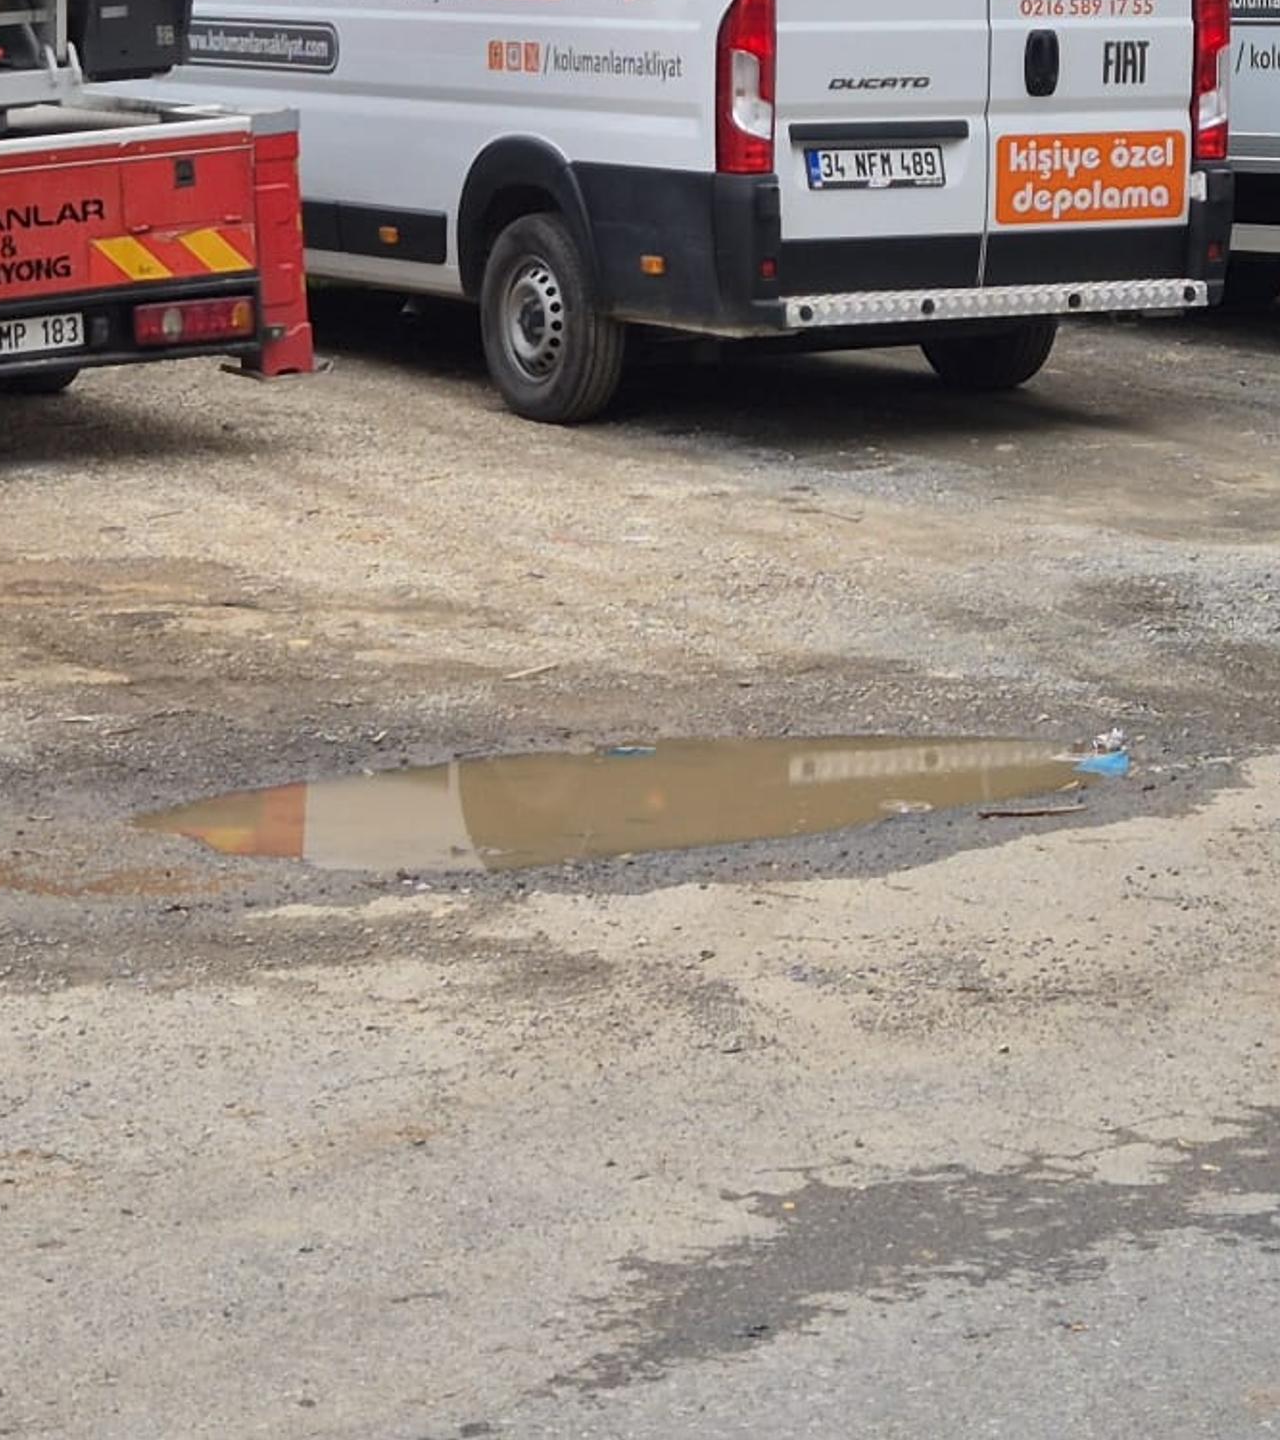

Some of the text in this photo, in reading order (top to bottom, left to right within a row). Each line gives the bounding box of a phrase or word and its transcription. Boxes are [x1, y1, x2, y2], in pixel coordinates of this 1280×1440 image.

[1103, 40, 1150, 84] FIAT
[828, 76, 930, 90] DUCATO
[821, 153, 845, 178] 34
[855, 152, 893, 178] NFM
[901, 151, 937, 176] 489
[1009, 137, 1174, 180] kişiye özel
[1012, 179, 1170, 220] depolama
[0, 235, 17, 258] &
[41, 317, 78, 344] 183
